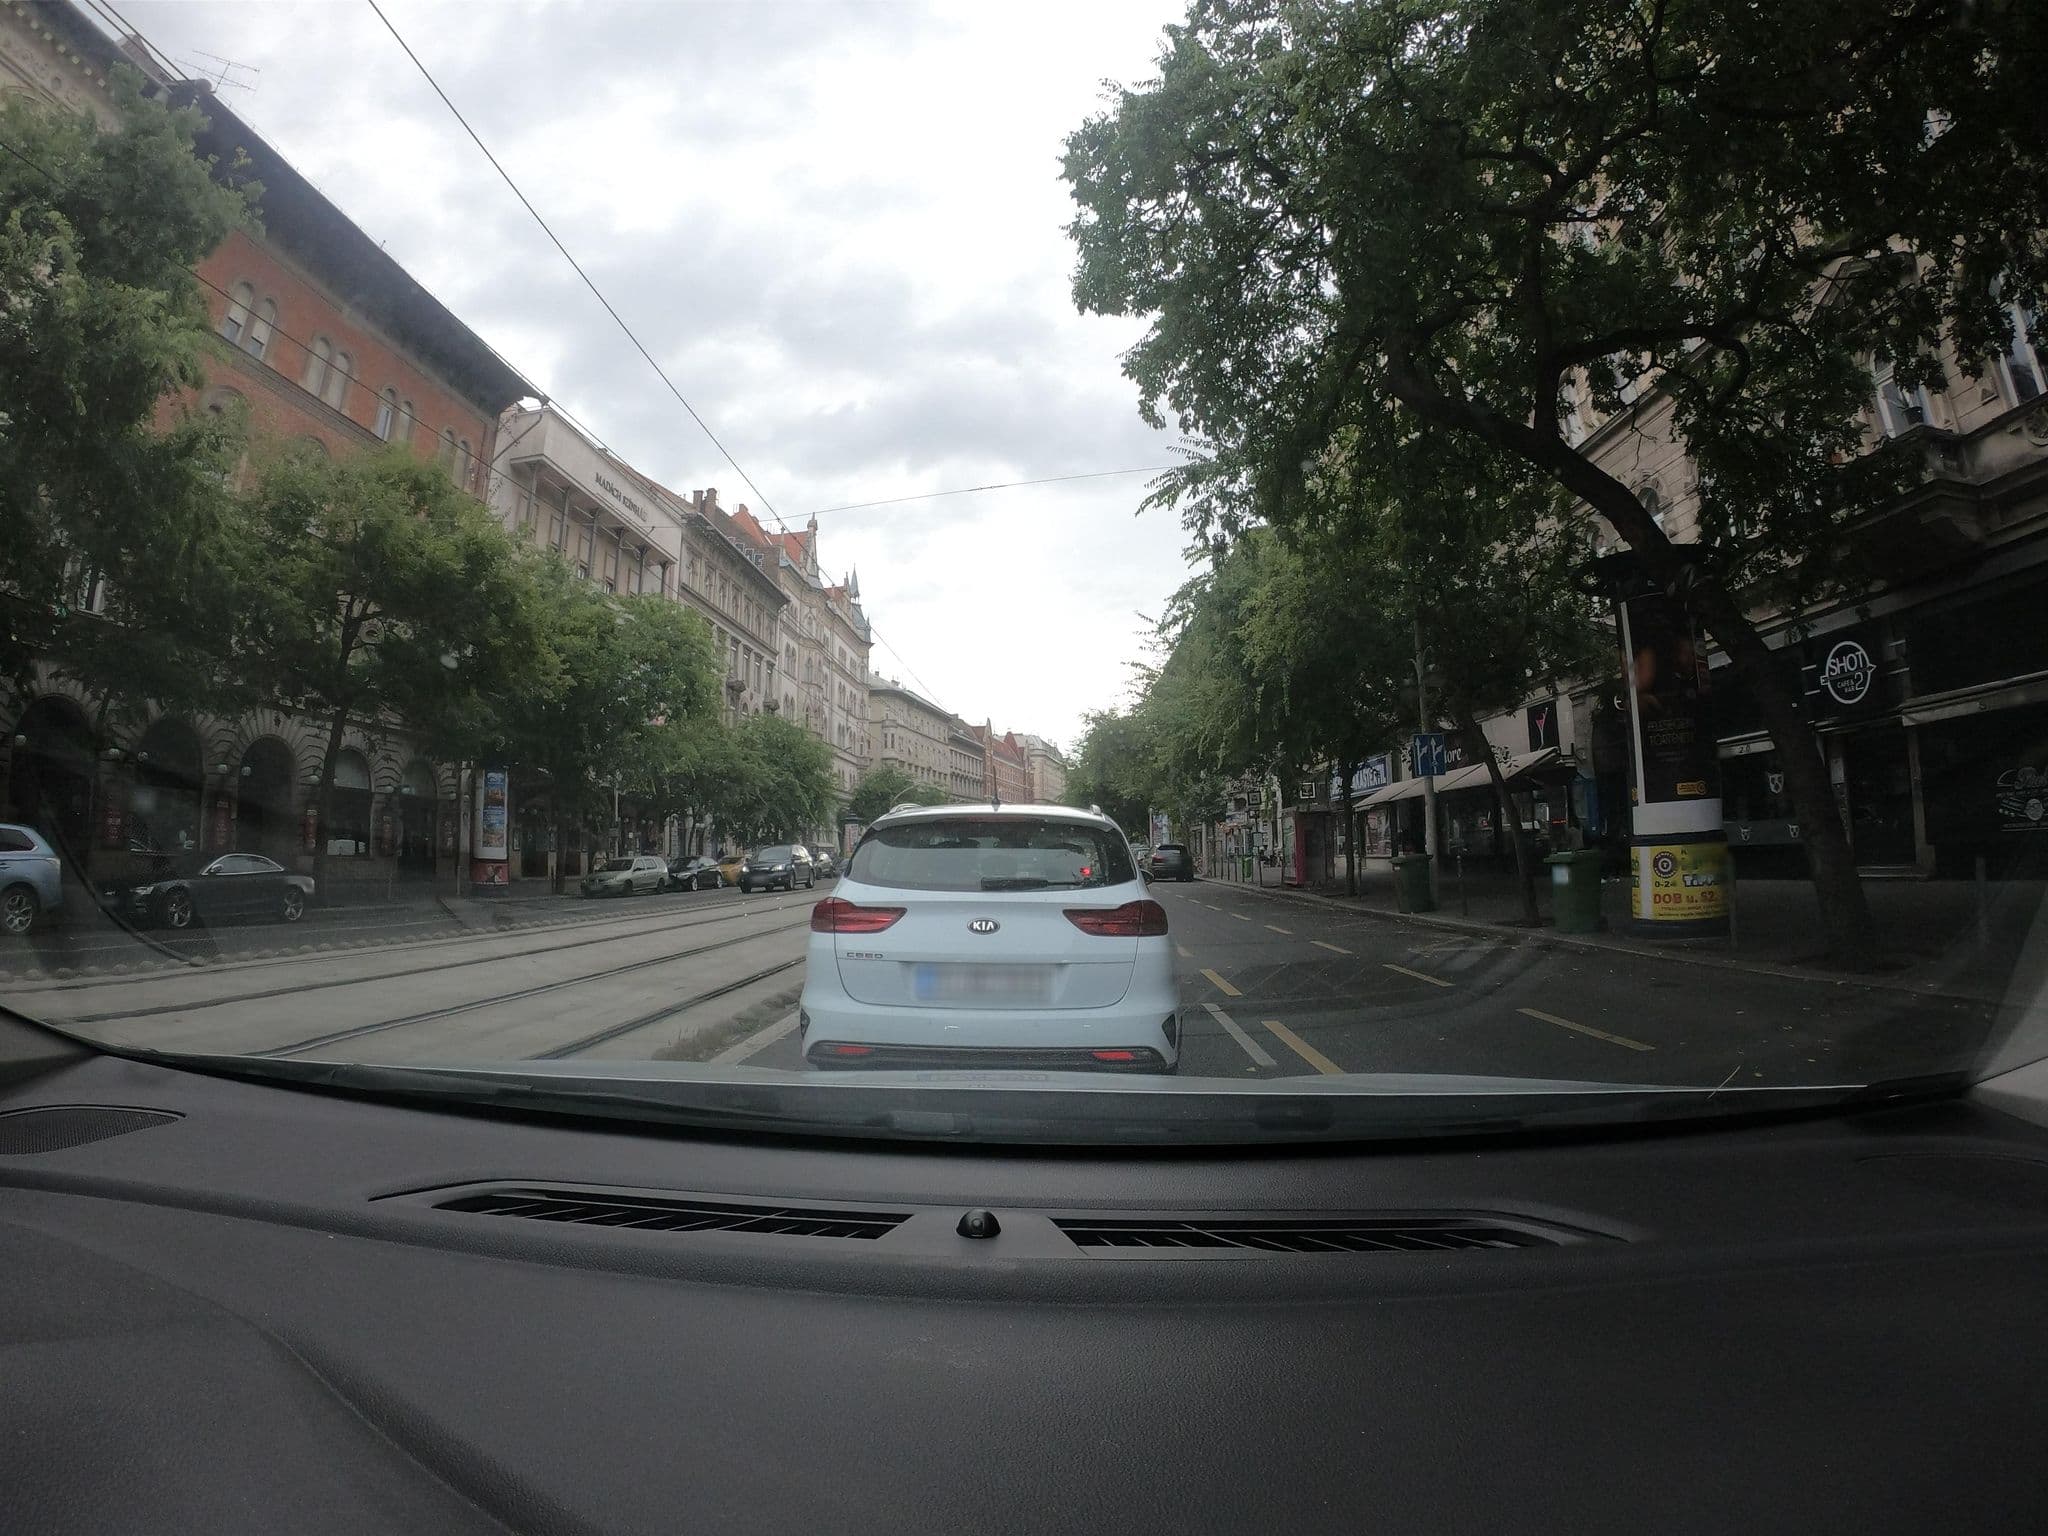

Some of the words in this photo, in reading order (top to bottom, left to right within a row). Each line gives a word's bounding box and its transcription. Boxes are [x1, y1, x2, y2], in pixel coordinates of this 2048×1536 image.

[1829, 651, 1863, 676] SHOT
[1654, 892, 1682, 904] DOB
[973, 921, 995, 931] KIA
